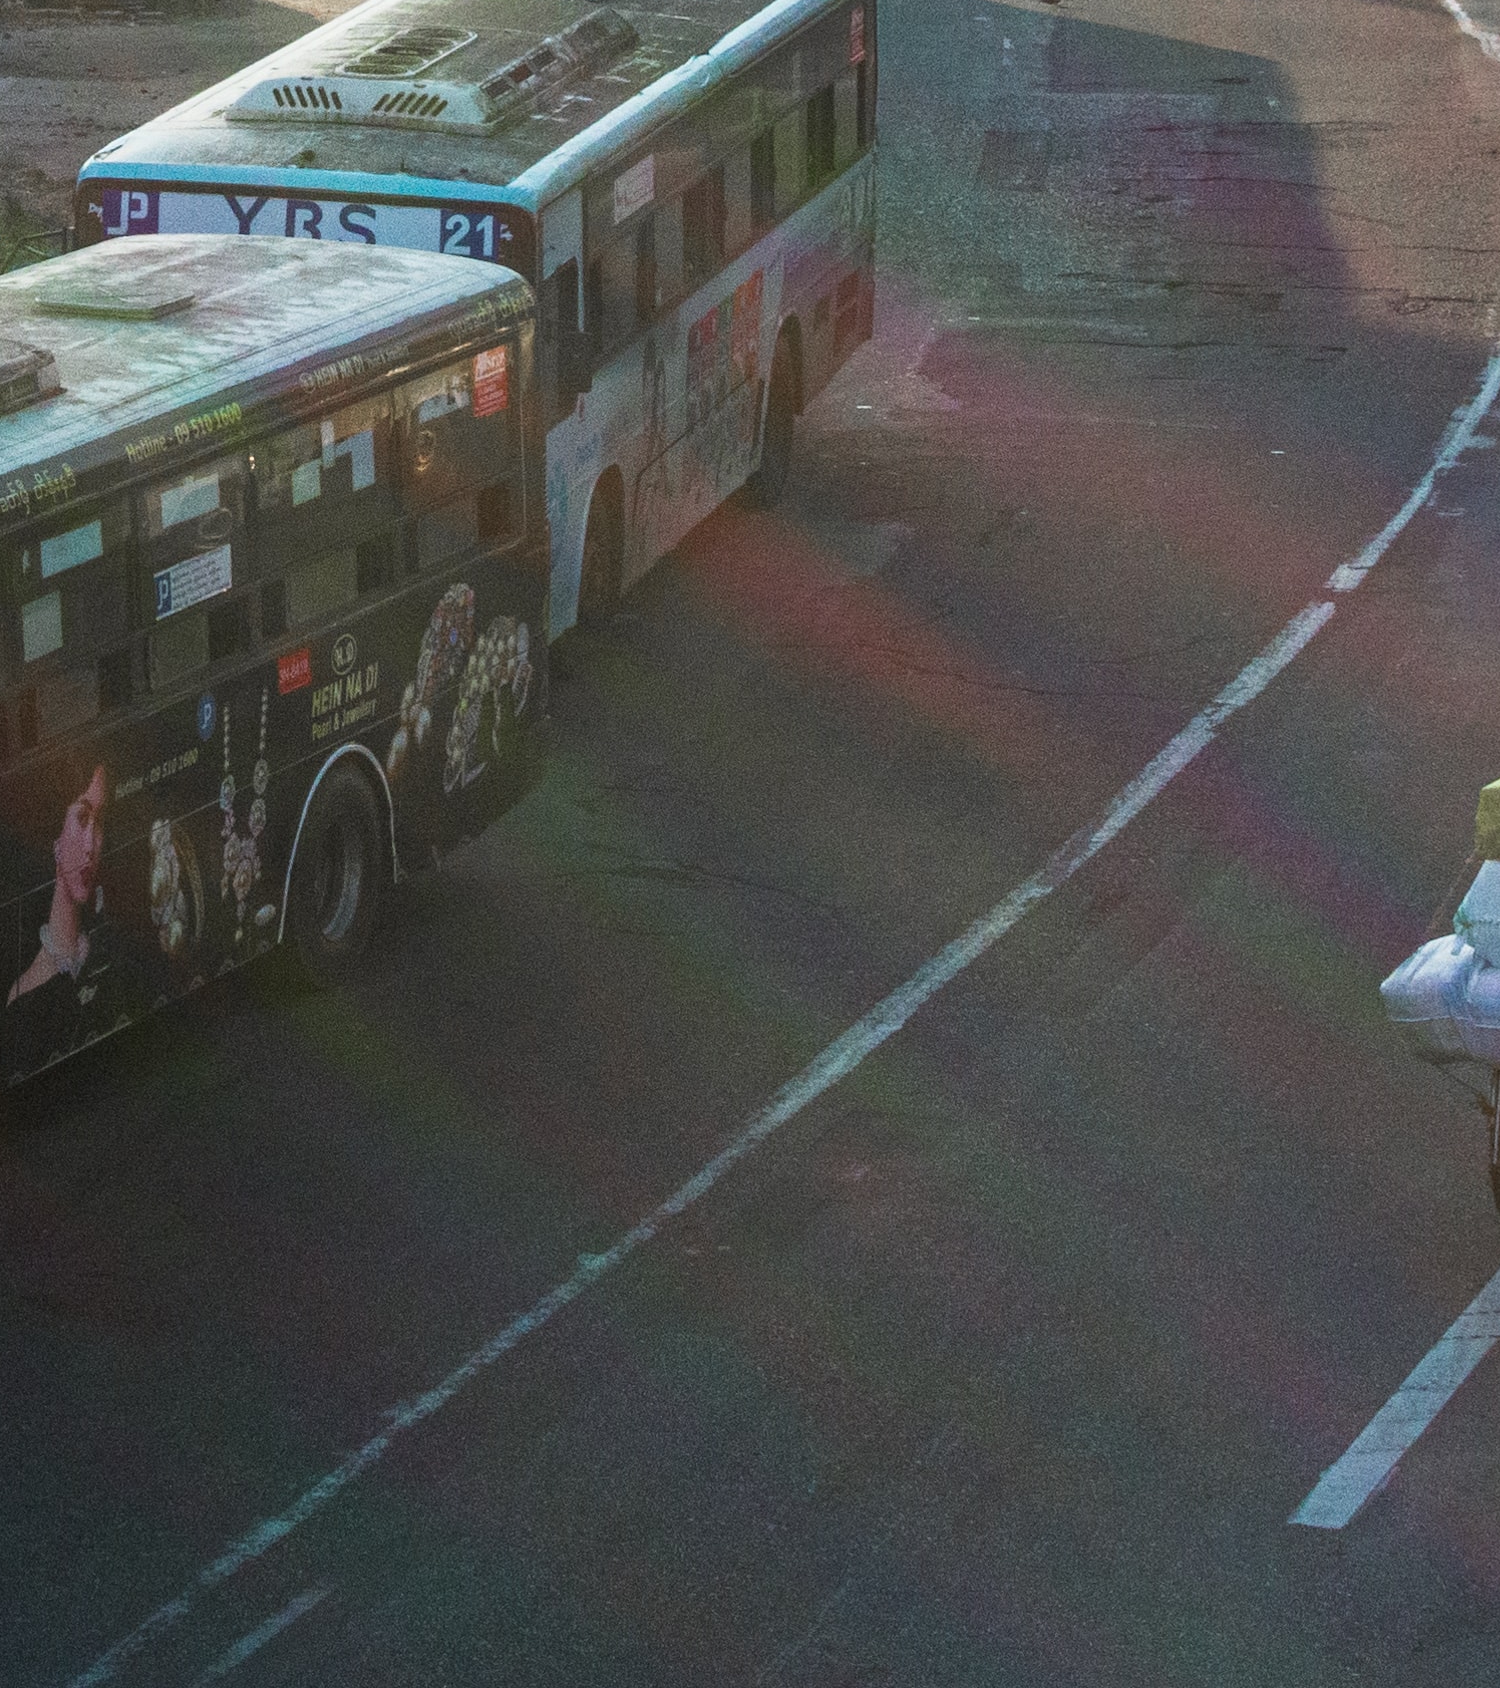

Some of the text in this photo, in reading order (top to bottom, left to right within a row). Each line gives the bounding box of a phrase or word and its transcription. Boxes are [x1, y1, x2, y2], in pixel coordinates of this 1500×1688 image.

[444, 214, 496, 257] 21
[311, 678, 342, 718] HEIN
[345, 669, 362, 703] NA
[365, 660, 379, 693] DI
